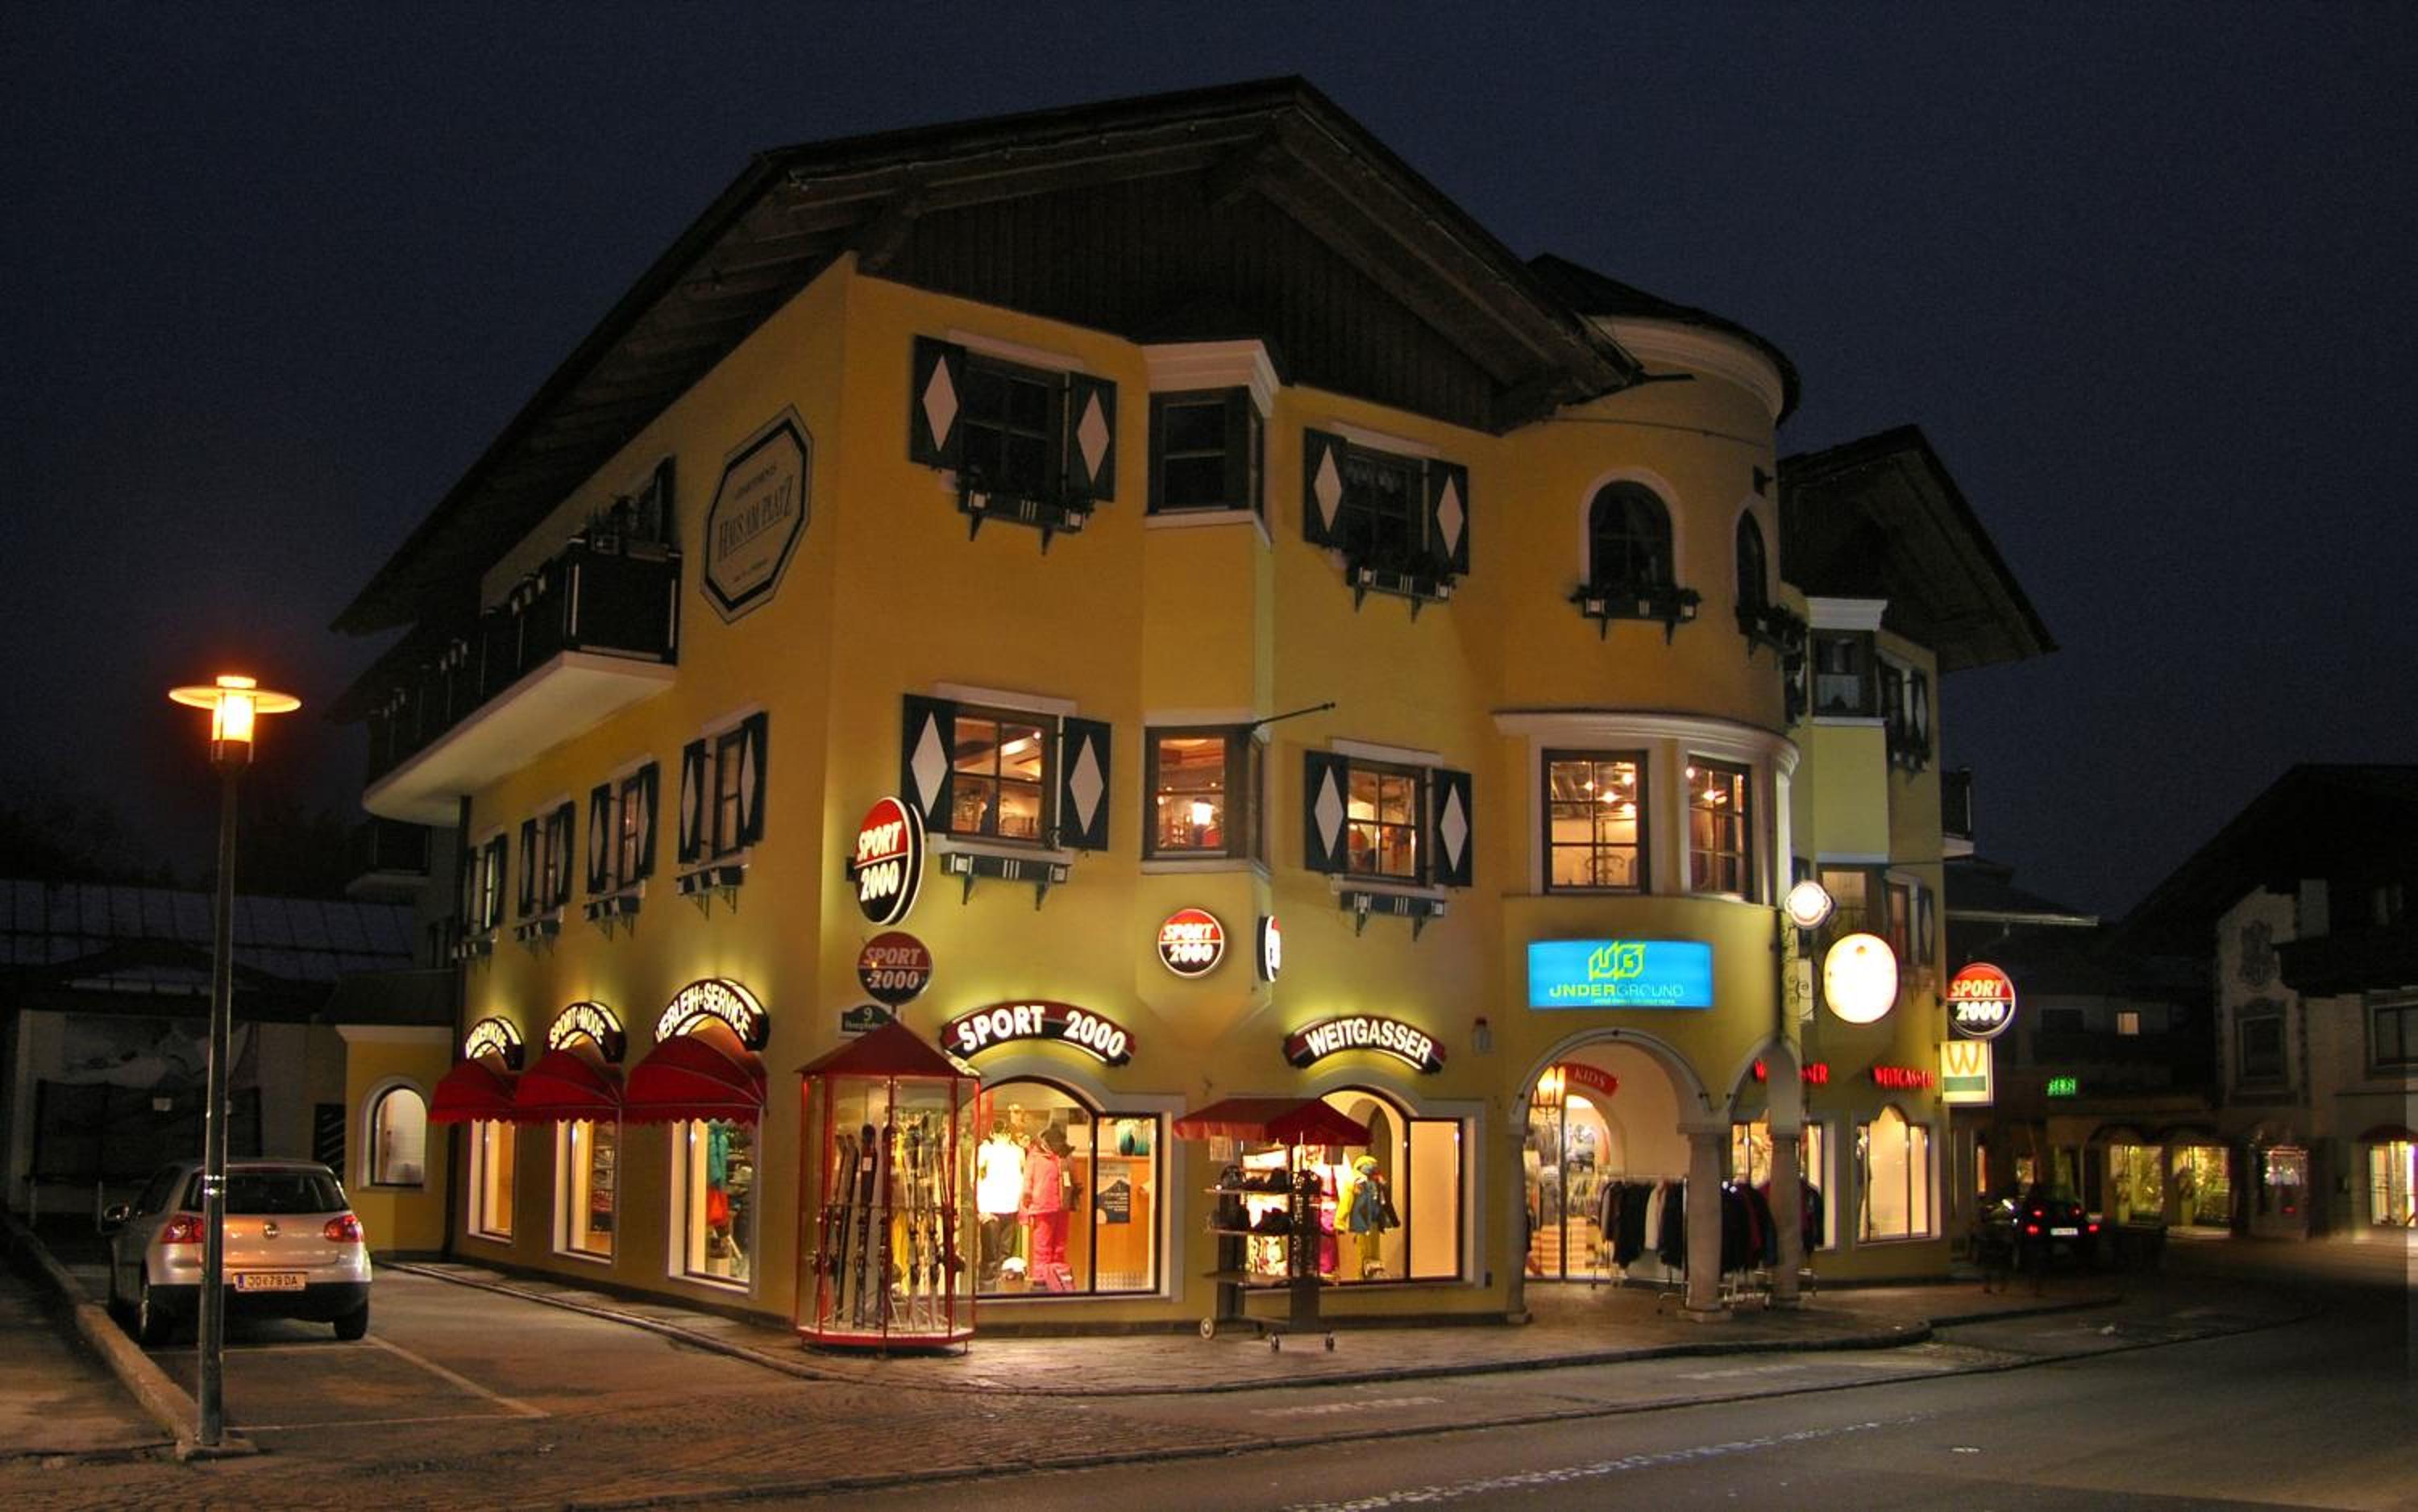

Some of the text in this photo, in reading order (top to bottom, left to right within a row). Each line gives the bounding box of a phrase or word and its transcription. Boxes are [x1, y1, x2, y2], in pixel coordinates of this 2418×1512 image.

[857, 820, 902, 862] SPORT
[860, 860, 899, 902] 2000
[1163, 924, 1215, 941] SPORT
[863, 947, 920, 966] SPORT
[1169, 943, 1213, 962] 2000
[869, 970, 919, 989] 2000
[1951, 979, 2005, 998] SPORT
[863, 1007, 873, 1021] 9
[1956, 1001, 2005, 1021] 2000
[958, 1005, 1126, 1058] SPORT 2000
[1305, 1017, 1432, 1065] WEITGASSER
[1573, 1067, 1606, 1087] KIDS
